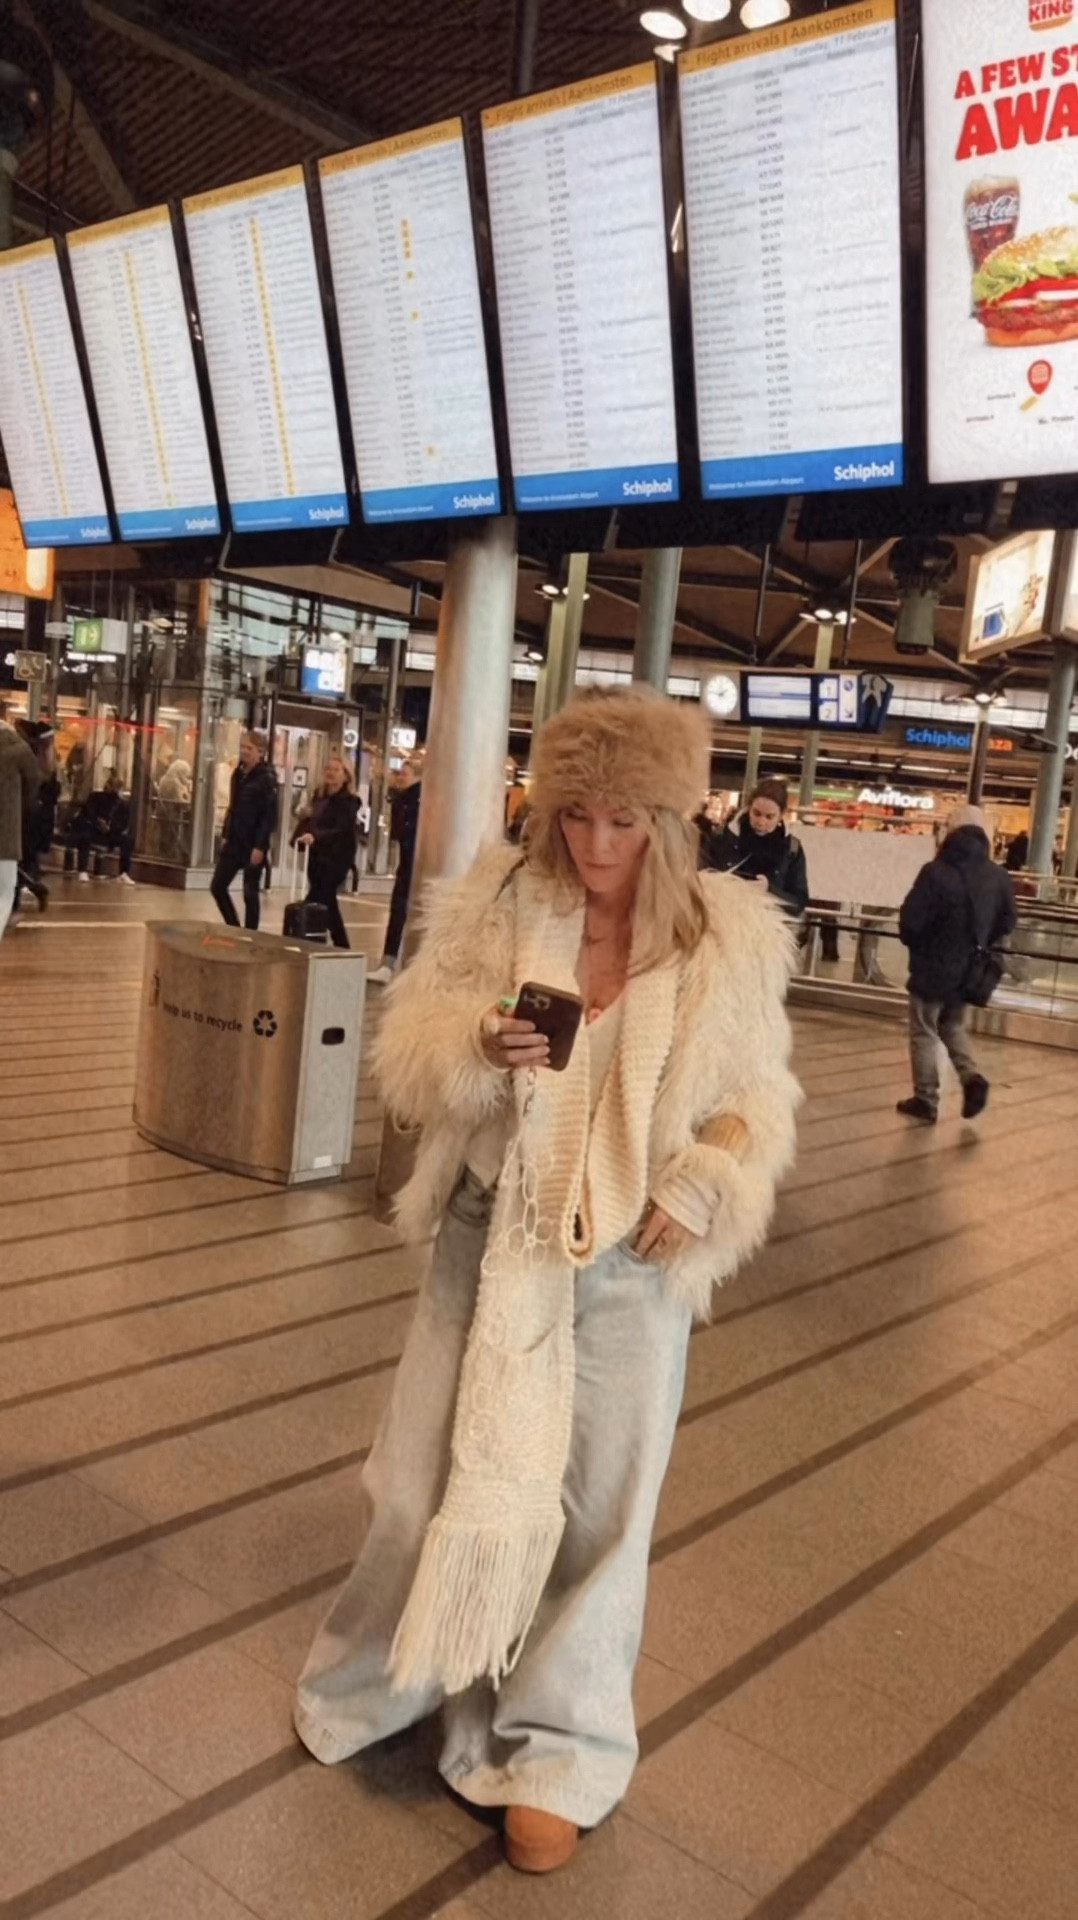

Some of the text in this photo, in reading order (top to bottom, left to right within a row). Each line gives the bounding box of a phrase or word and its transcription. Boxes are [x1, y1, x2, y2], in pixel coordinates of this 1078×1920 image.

[1029, 0, 1073, 23] KING
[697, 8, 873, 66] Flight arrivals Aankomsten
[954, 70, 976, 99] A
[981, 52, 1046, 93] FEW
[496, 75, 633, 121] Flight arrivals Aankomsten
[834, 460, 895, 482] Schiphol
[622, 478, 673, 497] Schiphol
[453, 493, 496, 510] Schiphol
[308, 506, 345, 521] Schiphol
[185, 518, 216, 531] Schiphol
[906, 728, 970, 747] Schiphol
[858, 786, 934, 809] Aviflora
[194, 1011, 204, 1023] to
[206, 1016, 243, 1032] recycle
